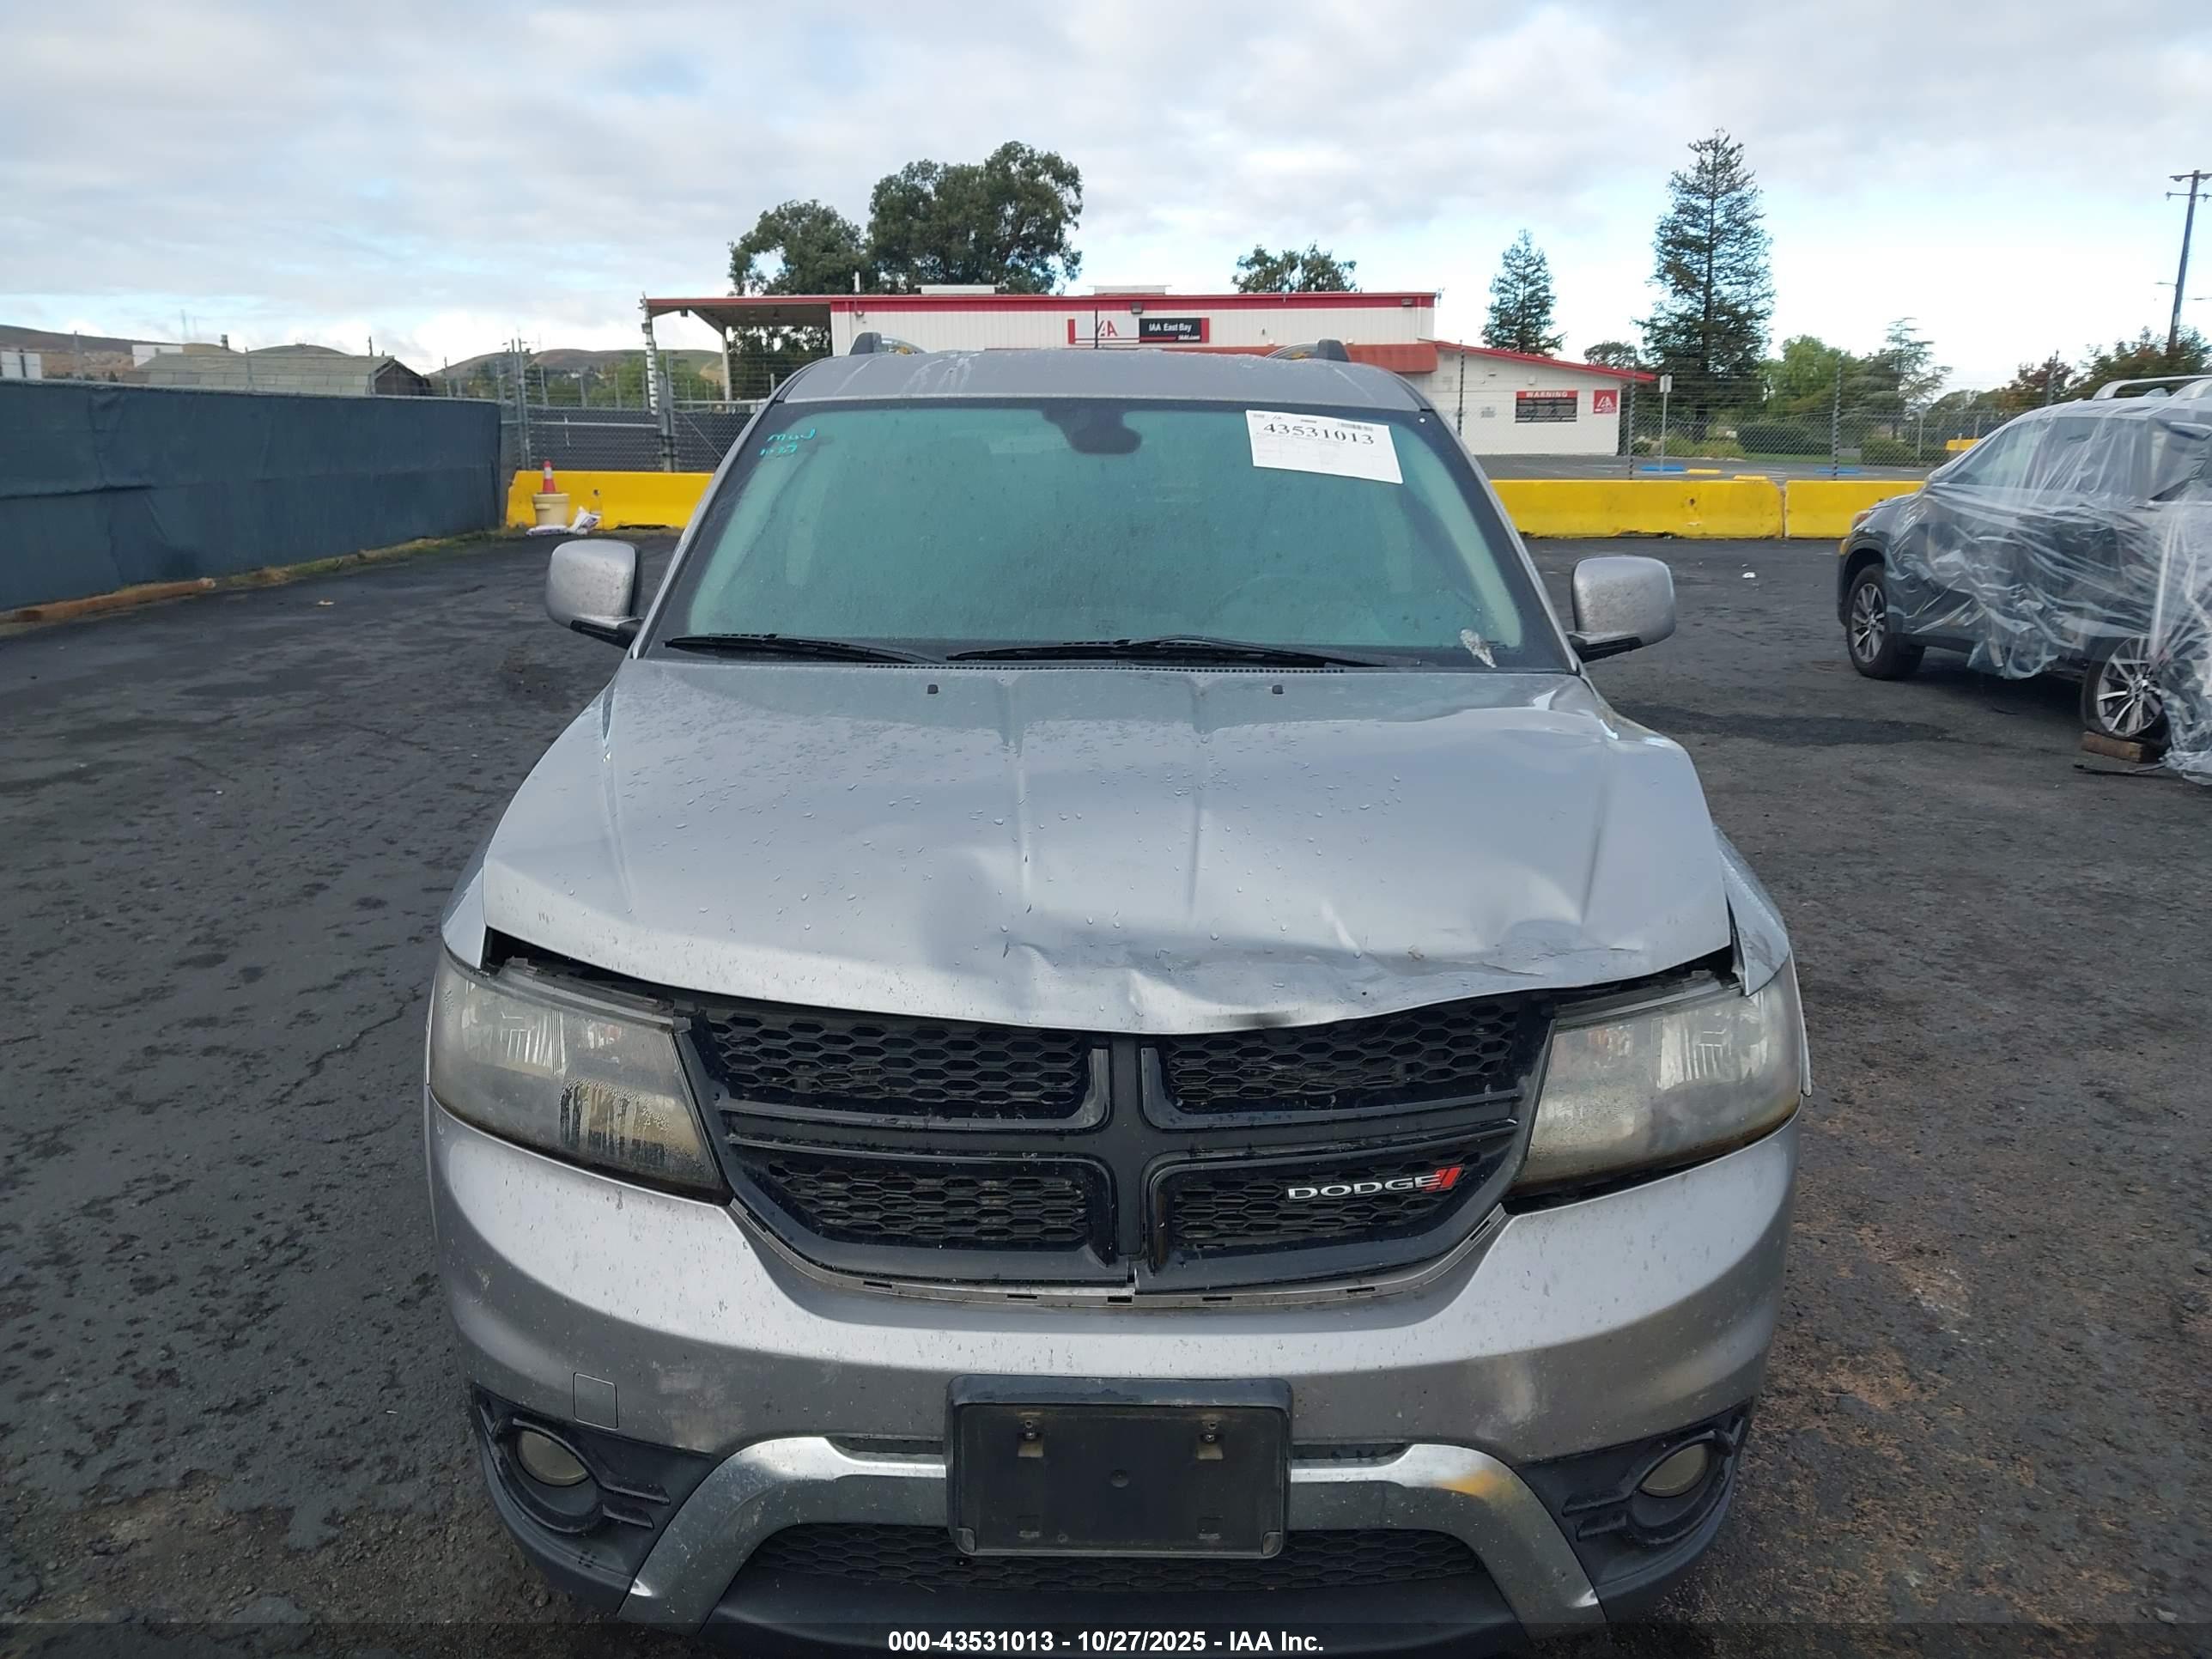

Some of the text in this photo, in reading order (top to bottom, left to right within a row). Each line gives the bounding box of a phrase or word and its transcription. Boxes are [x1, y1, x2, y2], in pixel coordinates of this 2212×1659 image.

[1148, 323, 1193, 332] IAA East Bay
[1263, 422, 1375, 446] 43531013
[1288, 1174, 1442, 1200] DODGE
